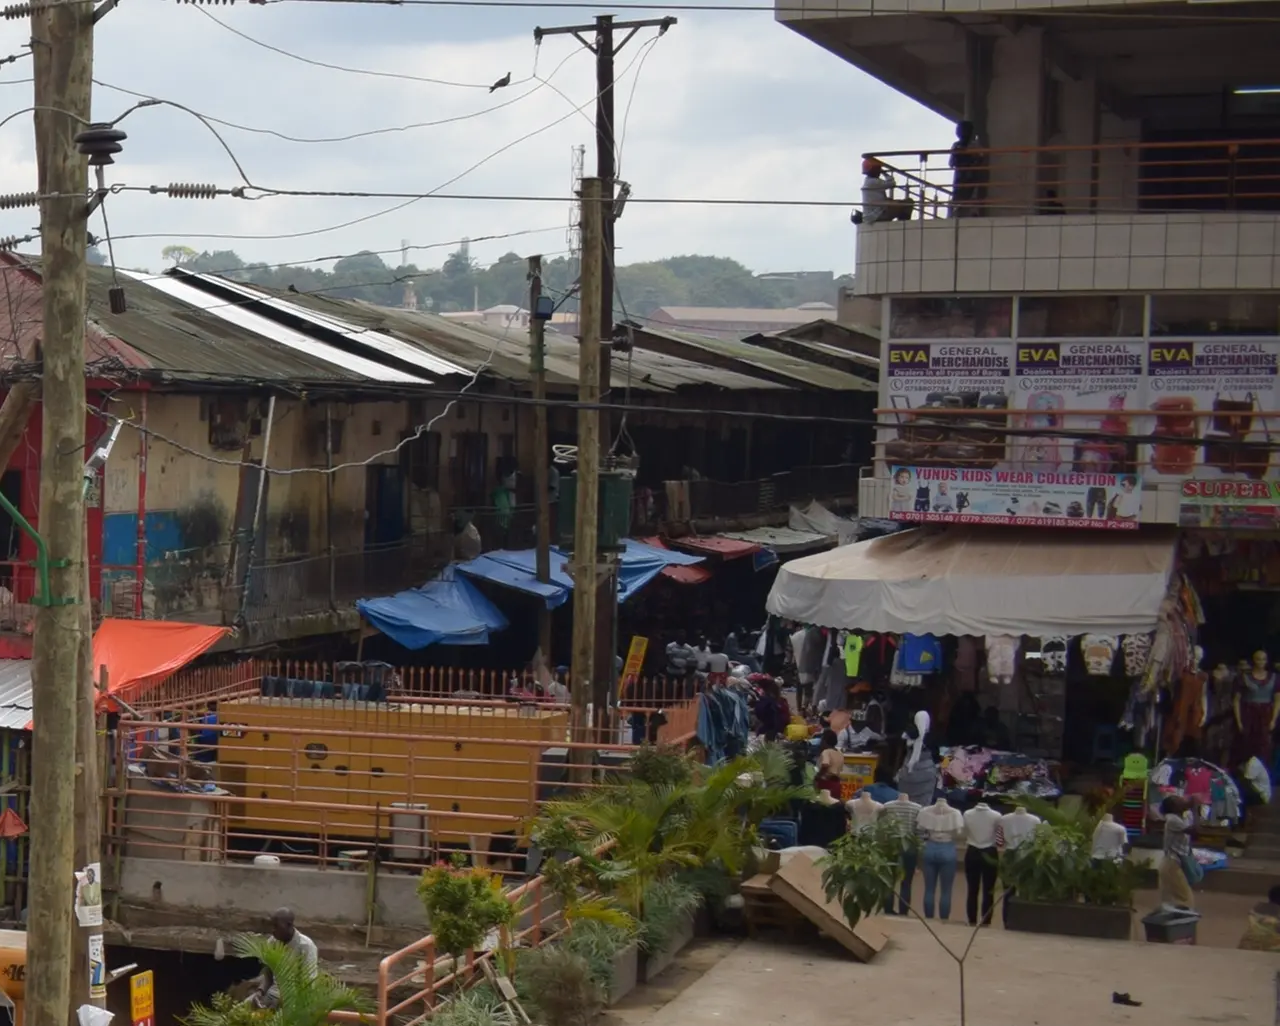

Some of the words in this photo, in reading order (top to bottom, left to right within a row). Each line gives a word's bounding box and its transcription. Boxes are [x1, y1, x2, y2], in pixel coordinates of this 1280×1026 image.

[939, 347, 997, 355] GENERAL
[1070, 345, 1130, 354] GENERAL
[1151, 348, 1190, 361] EVA
[1203, 344, 1266, 353] GENERAL
[890, 350, 928, 363] EVA
[1018, 349, 1056, 361] EVA
[1062, 354, 1142, 366] MERCHANDISE
[1195, 354, 1277, 366] MERCHANDISE
[931, 357, 1008, 367] MERCHANDISE
[1078, 368, 1100, 376] types
[1211, 368, 1234, 376] types
[915, 468, 958, 481] YUNUS
[962, 470, 992, 482] KIDS
[996, 471, 1034, 483] WEAR
[1037, 472, 1116, 486] COLLECTION
[1183, 480, 1271, 498] SUPER
